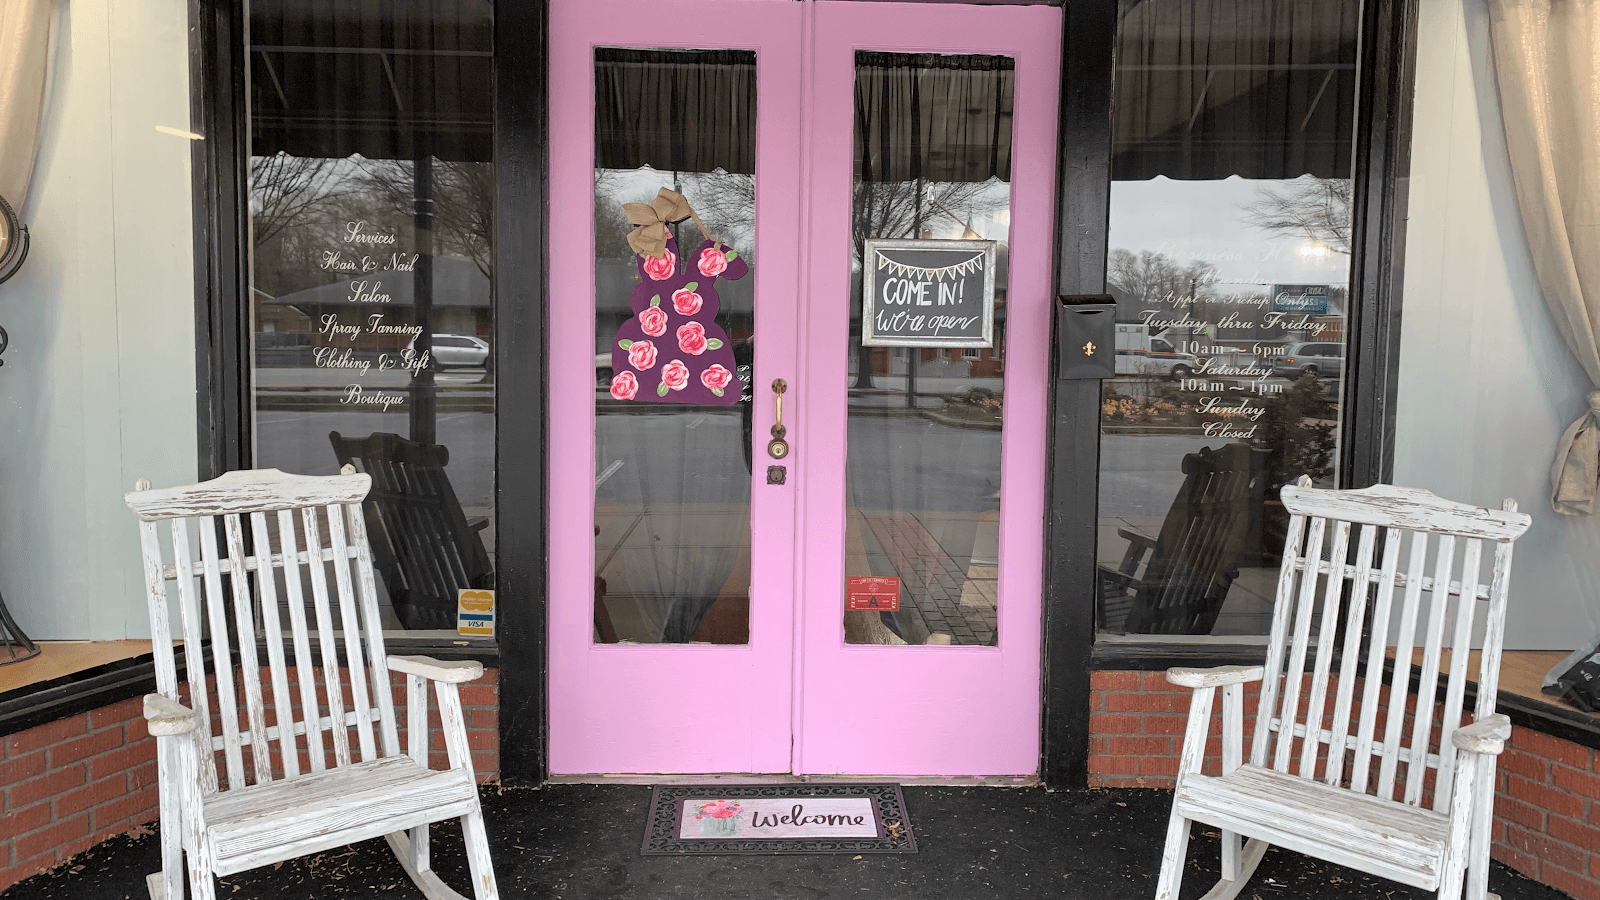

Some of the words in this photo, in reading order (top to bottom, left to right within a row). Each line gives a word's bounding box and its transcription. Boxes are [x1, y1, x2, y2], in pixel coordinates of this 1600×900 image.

[344, 221, 395, 244] Services
[320, 251, 357, 271] Hair
[362, 255, 378, 272] &
[384, 252, 419, 272] Nail
[1190, 266, 1276, 292] Monday
[347, 280, 392, 303] Salon
[882, 277, 933, 306] COME
[937, 278, 965, 306] IN!
[1155, 289, 1198, 309] Appt
[1205, 297, 1217, 305] or
[1223, 292, 1270, 309] Pickup
[318, 313, 361, 342] Spray
[366, 313, 423, 342] Tanning
[927, 314, 979, 337] open
[1138, 309, 1208, 335] Tuesday
[1217, 311, 1254, 330] thru
[1260, 311, 1327, 337] Friday
[1181, 340, 1224, 356] 10am
[1252, 341, 1285, 359] 6pm
[313, 346, 371, 376] Clothing
[378, 353, 397, 372] &
[400, 348, 430, 377] Gift
[1192, 357, 1274, 382] Saturday
[340, 383, 404, 412] Boutique
[1179, 378, 1224, 392] 10am
[1250, 378, 1283, 395] 1pm
[1195, 396, 1266, 422] Sunday
[1201, 422, 1258, 440] Closed
[467, 620, 484, 628] VISA
[752, 804, 867, 828] Welcome
